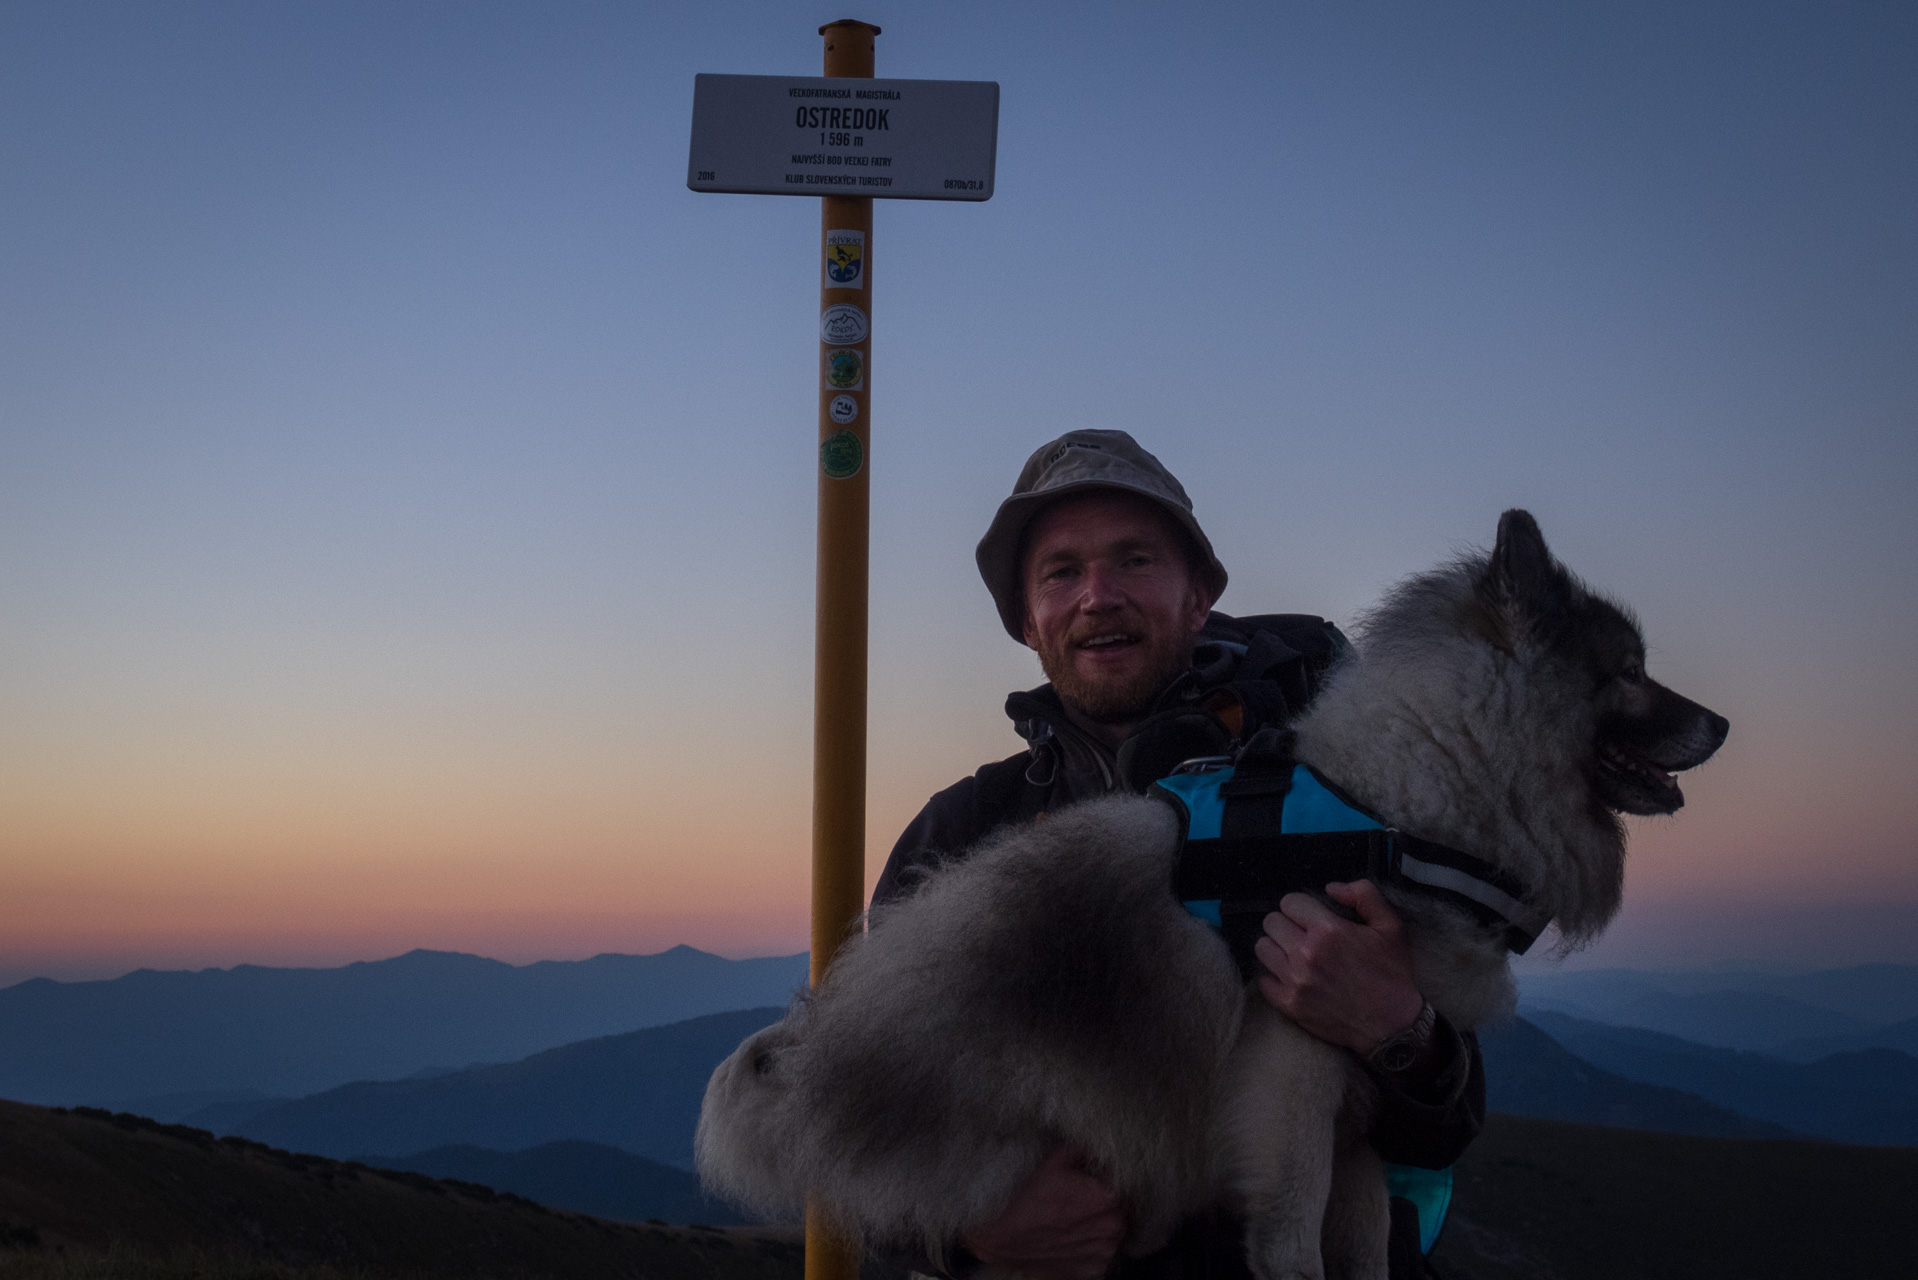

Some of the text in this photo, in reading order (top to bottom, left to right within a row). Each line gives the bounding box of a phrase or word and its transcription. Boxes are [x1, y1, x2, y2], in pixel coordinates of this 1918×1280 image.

[856, 89, 901, 100] MAGISTRÁLA
[796, 106, 890, 130] OSTREDOK
[820, 132, 864, 146] 1 596 m
[791, 154, 825, 165] NAJVYŠŠÍ
[827, 156, 842, 165] BOD
[871, 157, 892, 167] FATRY
[697, 171, 715, 181] 2016
[785, 174, 892, 187] KLUB SLOVENSKÝCH TURISTOV
